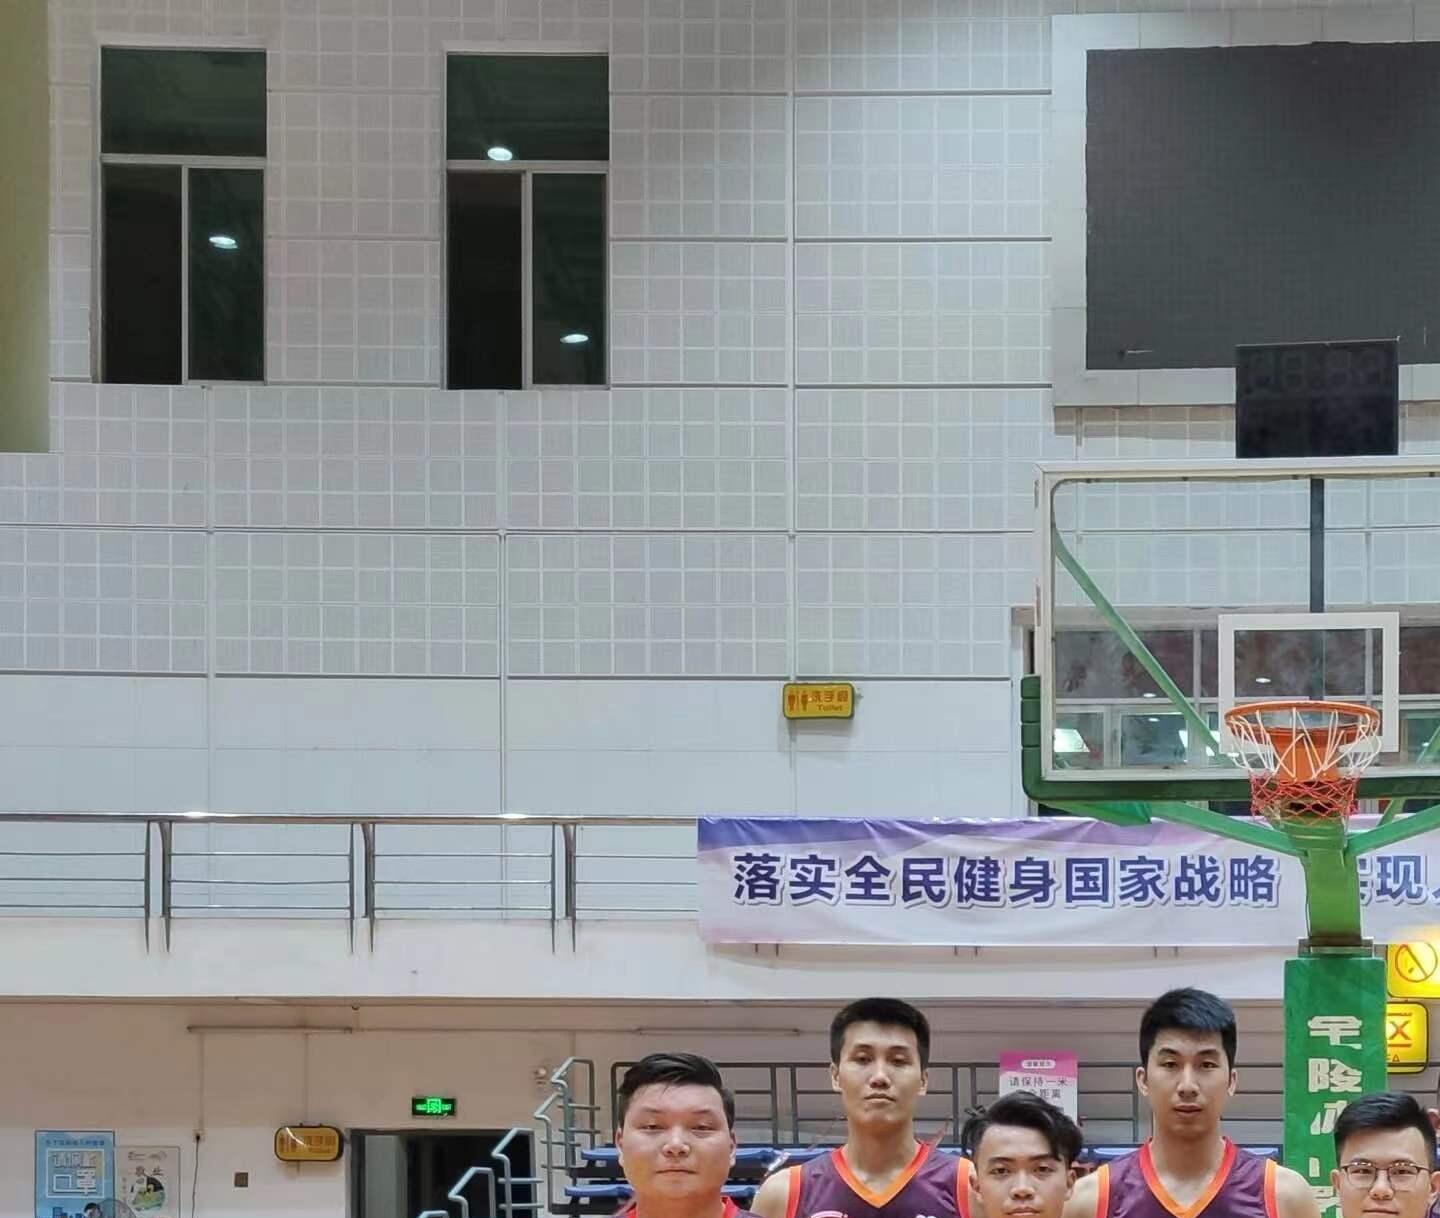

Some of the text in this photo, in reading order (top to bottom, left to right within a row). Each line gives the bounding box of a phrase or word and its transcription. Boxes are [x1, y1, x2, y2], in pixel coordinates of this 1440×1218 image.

[732, 852, 1280, 906] 落实全民健身国家战略
[1009, 1076, 1069, 1087] 请保持一米
